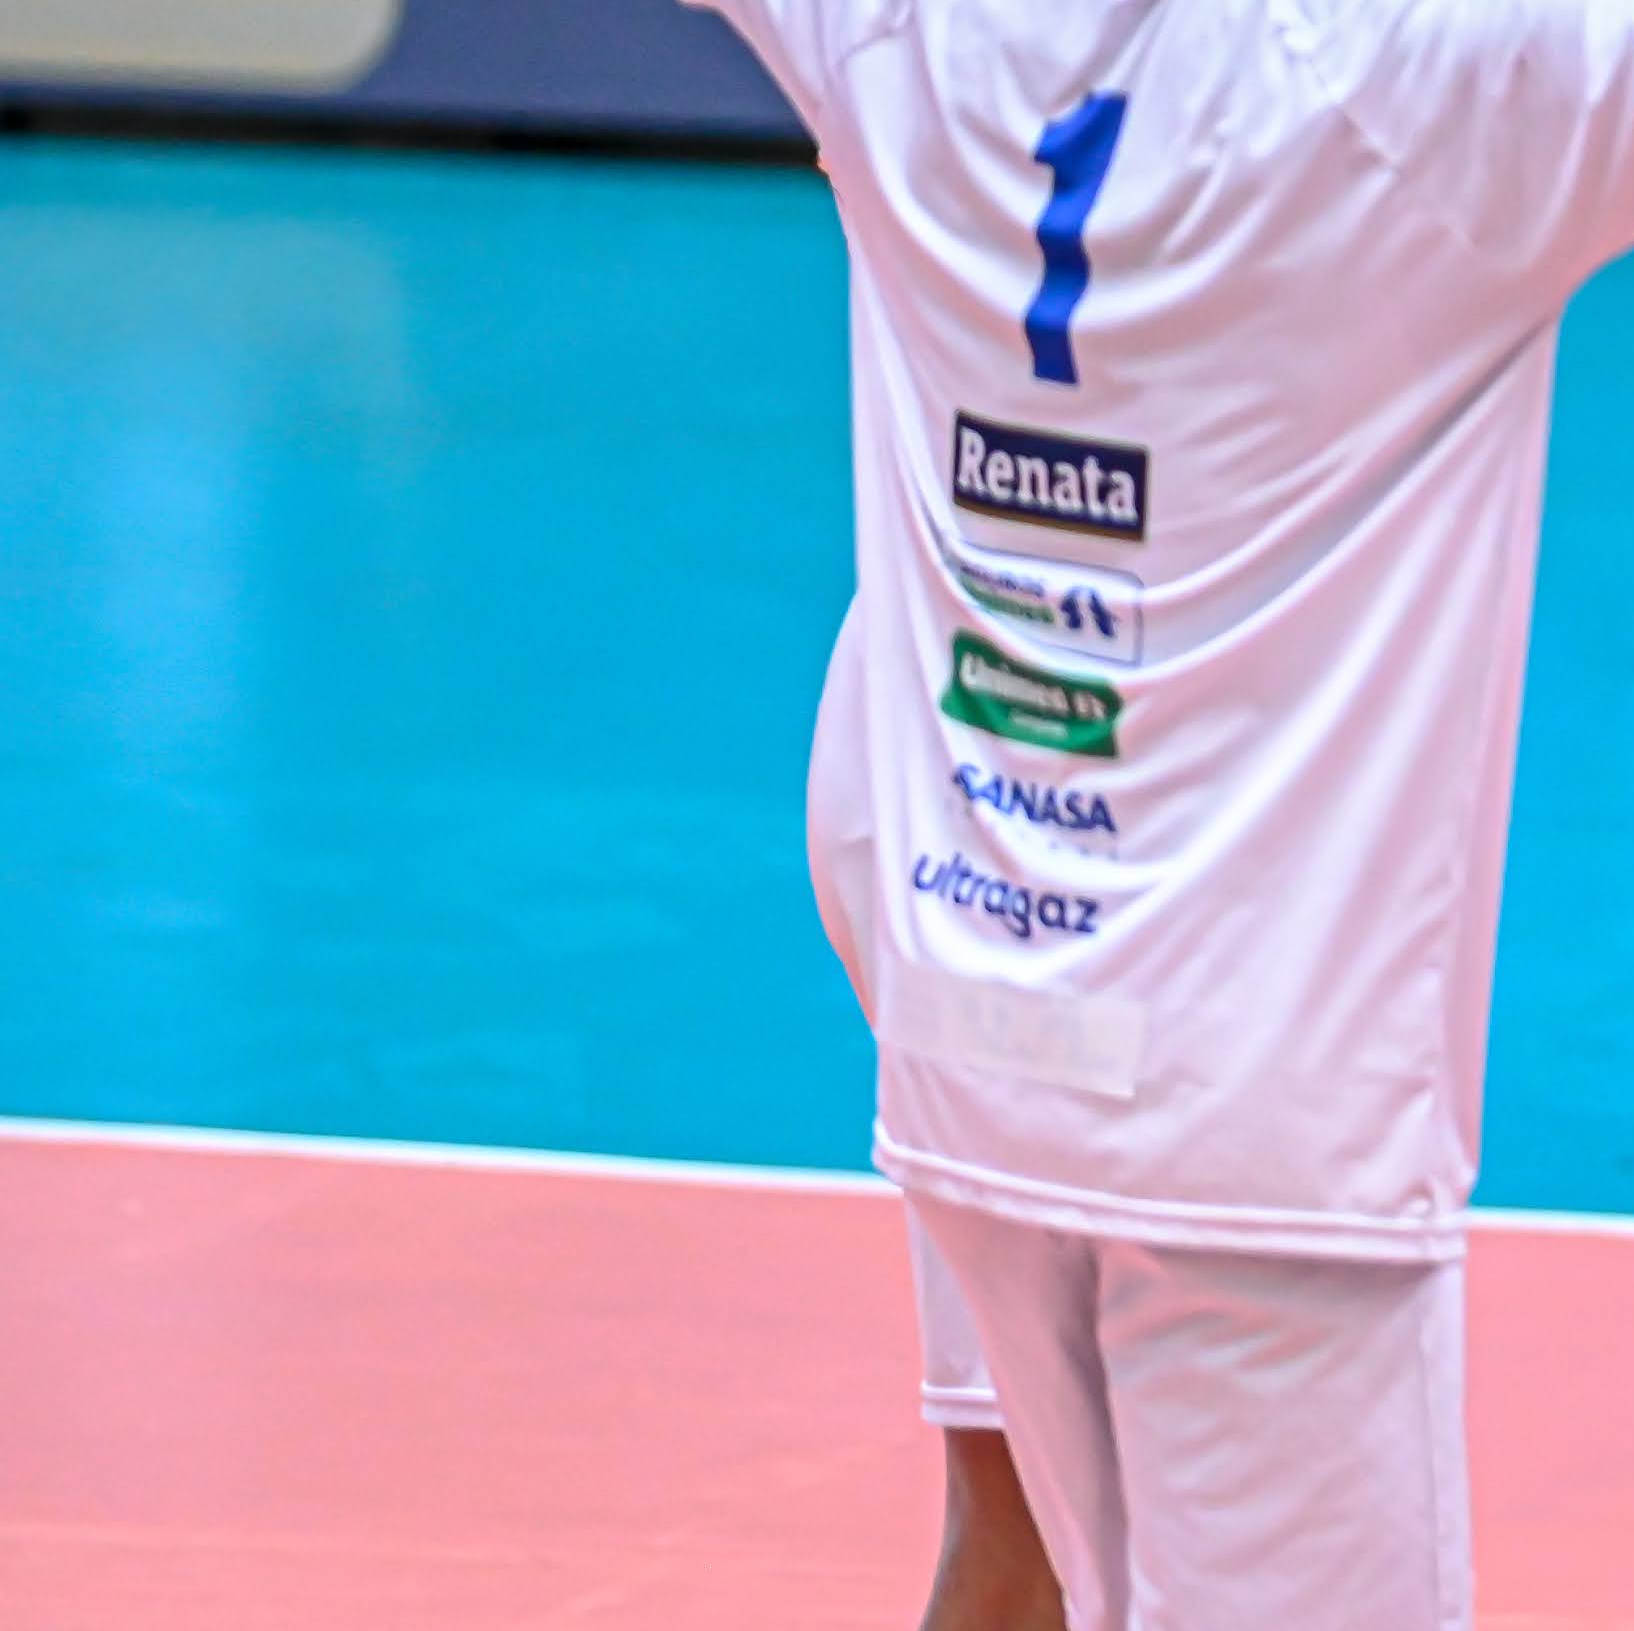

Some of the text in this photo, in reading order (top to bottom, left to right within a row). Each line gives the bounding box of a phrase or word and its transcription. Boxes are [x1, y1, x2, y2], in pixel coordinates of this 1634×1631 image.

[1024, 89, 1128, 386] 1
[957, 424, 1139, 524] Renata
[912, 850, 1099, 940] ultragaz
